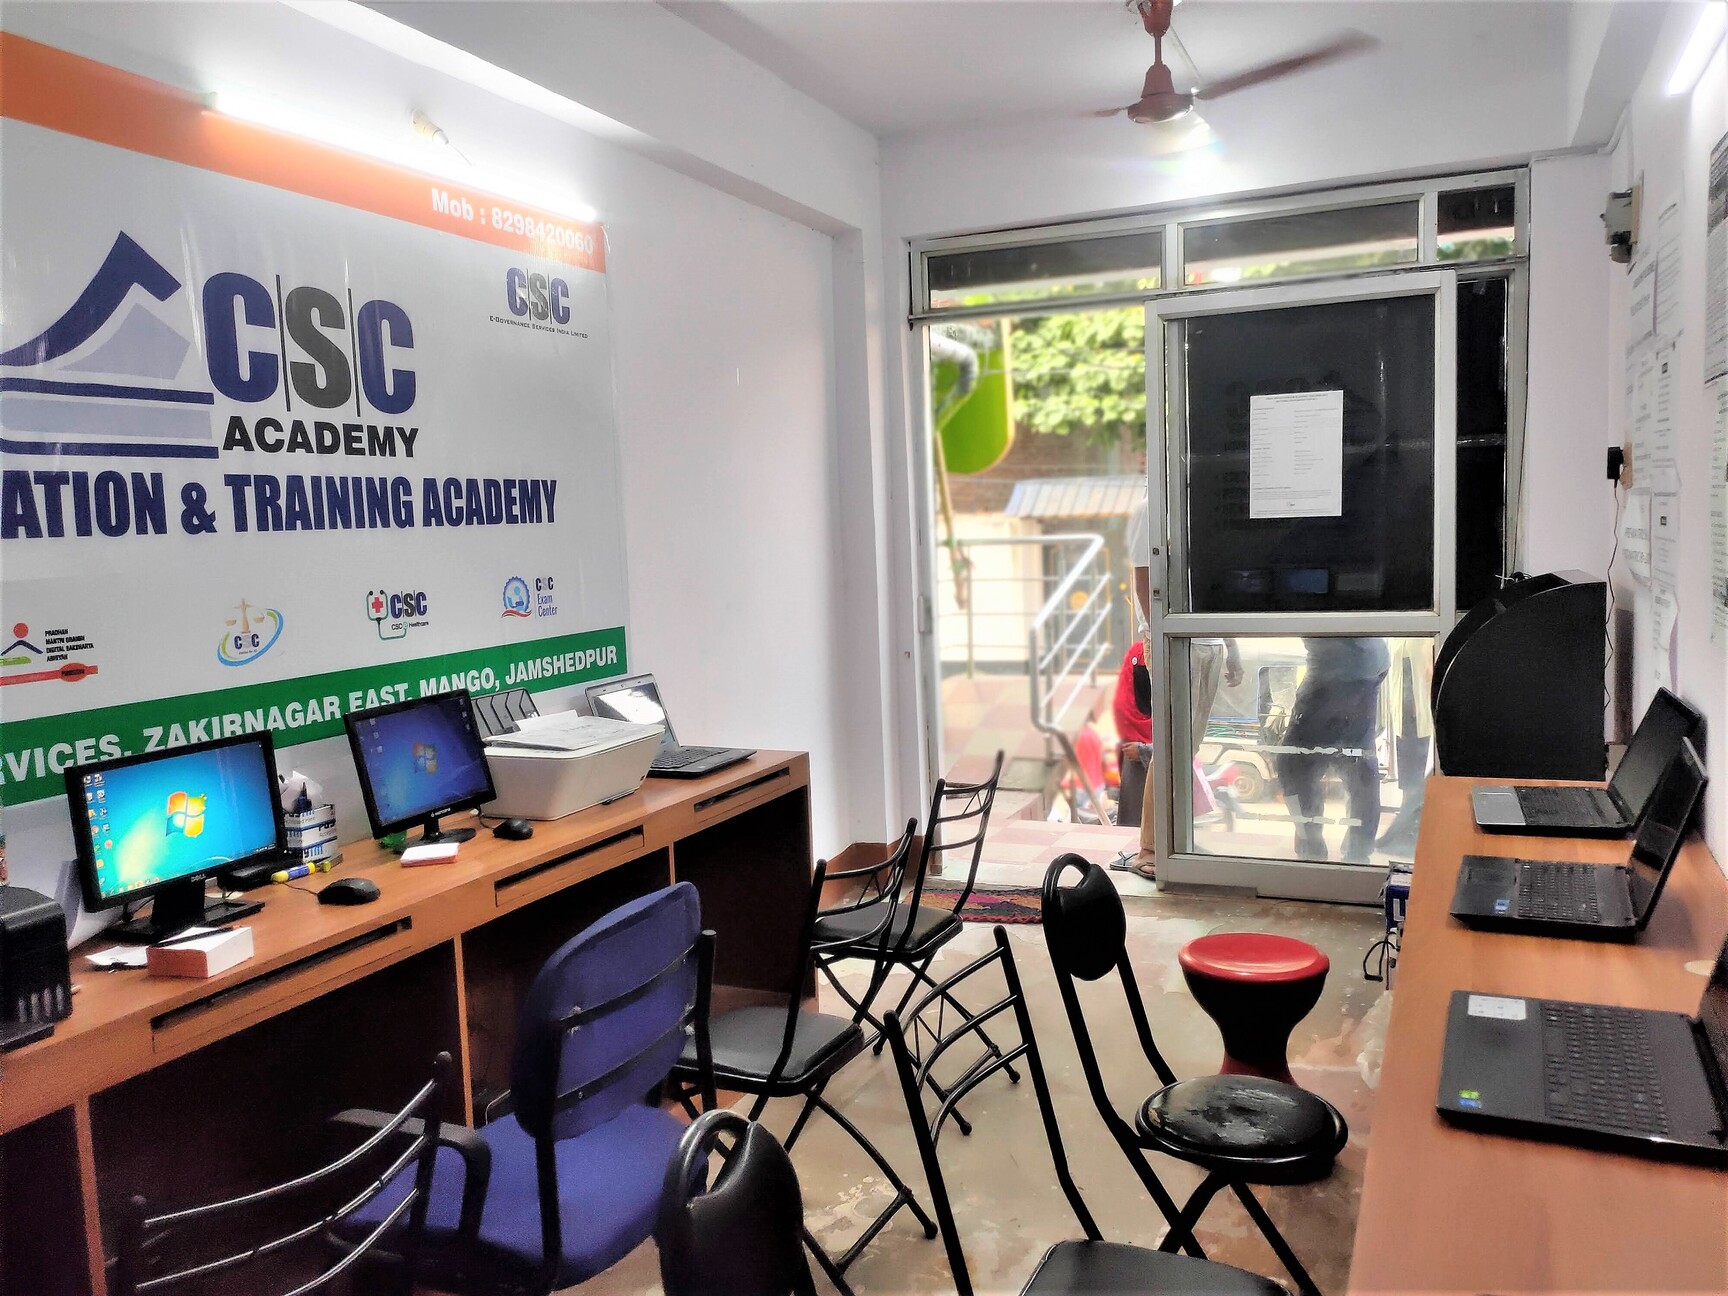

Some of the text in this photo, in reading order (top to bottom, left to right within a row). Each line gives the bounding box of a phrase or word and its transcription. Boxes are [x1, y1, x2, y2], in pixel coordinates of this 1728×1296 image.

[431, 188, 474, 222] Mob
[491, 207, 594, 256] 8298420060
[202, 272, 416, 417] CSC
[222, 415, 419, 458] ACADEMY
[0, 470, 557, 539] ATION & TRAINING ACADEMY
[537, 593, 553, 604] Exam
[538, 605, 558, 617] Center
[143, 695, 342, 753] ZAKIRNAGAR
[349, 683, 412, 713] EAST
[419, 669, 499, 700] MANGO,
[505, 645, 617, 685] JAMSHEDPUR
